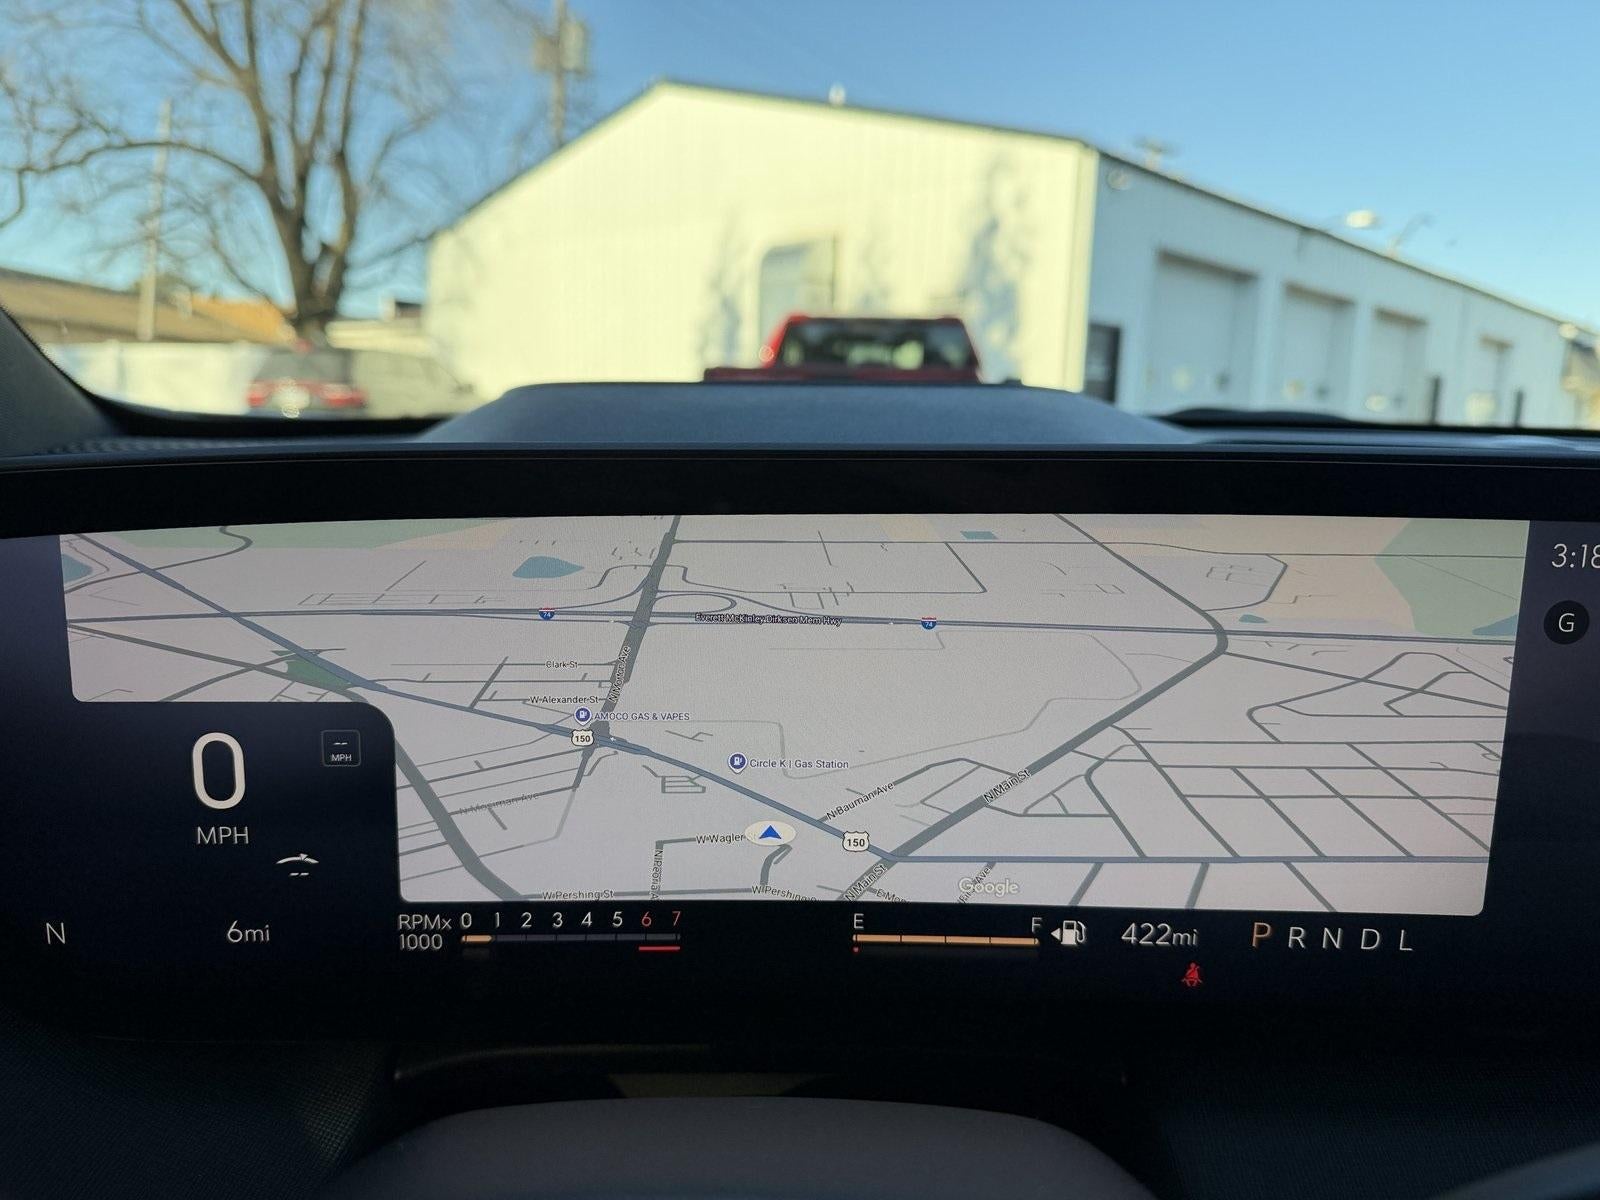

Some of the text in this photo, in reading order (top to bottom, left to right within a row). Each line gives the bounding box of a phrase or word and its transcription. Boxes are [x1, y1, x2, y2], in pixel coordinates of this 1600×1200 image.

[1551, 543, 1600, 569] 3:18
[726, 613, 763, 625] McKinley
[766, 615, 797, 624] Dirksen
[800, 616, 820, 625] Mem
[823, 616, 842, 627] Hwy
[1558, 612, 1575, 632] G
[618, 645, 630, 664] Ave
[542, 695, 587, 704] Alexander
[590, 695, 599, 704] St
[594, 712, 690, 721] AMOCO GAS & VAPES
[575, 734, 591, 743] 150
[331, 753, 352, 762] MPH
[750, 759, 777, 768] Circle
[780, 759, 786, 768] K
[794, 759, 813, 769] Gas
[815, 759, 849, 769] Station
[192, 732, 246, 810] 0
[984, 769, 1030, 803] N Main St
[826, 782, 894, 820] N Bauman Ave
[196, 826, 250, 845] MPH
[696, 834, 706, 844] W
[709, 833, 744, 844] Wagler
[847, 838, 866, 848] 150
[852, 875, 877, 896] Main
[873, 864, 886, 876] St
[975, 867, 991, 884] Ave
[542, 889, 613, 901] W Pershing St
[752, 885, 761, 894] W
[959, 877, 1019, 898] Google
[399, 913, 452, 930] RPMx
[461, 911, 681, 928] 0 1 2 3 4 5 6 7
[853, 913, 864, 929] E
[1031, 917, 1042, 932] F
[46, 922, 66, 945] N
[226, 920, 270, 943] 6mi
[1121, 922, 1198, 945] 422mi
[1252, 922, 1413, 950] P R N D L
[400, 933, 442, 950] 1000
